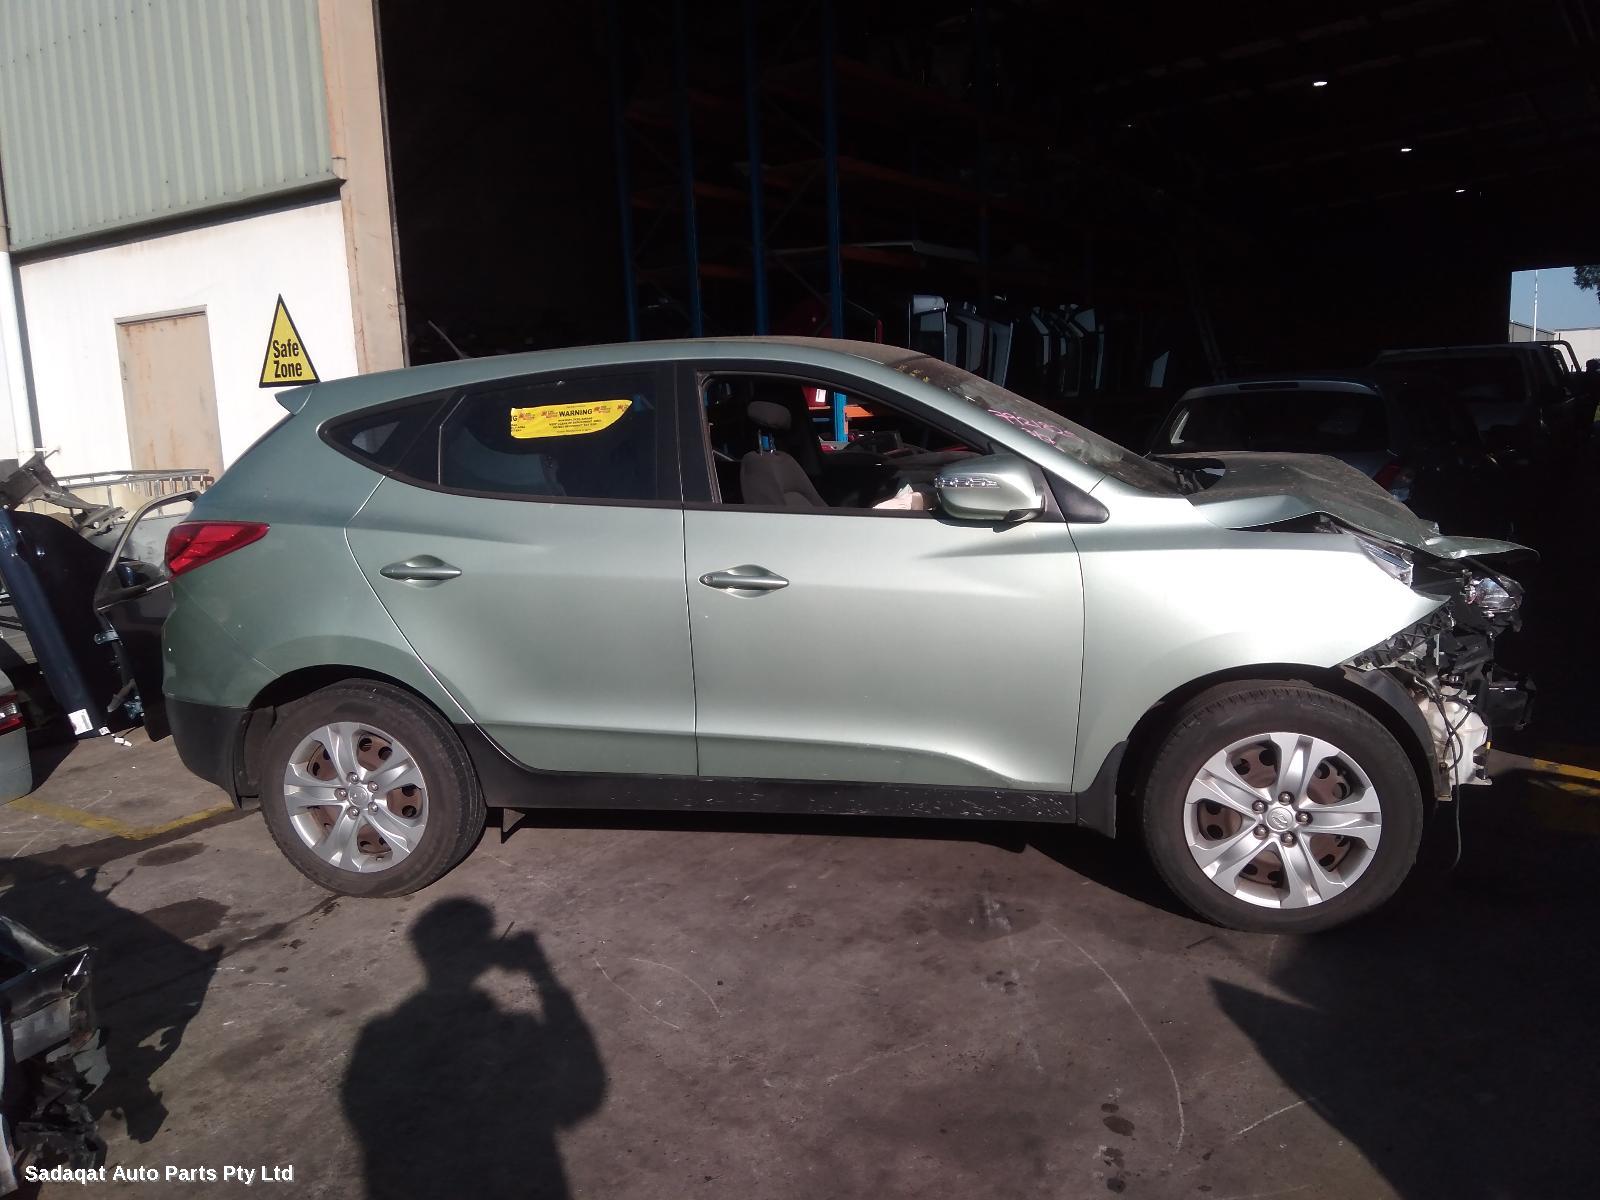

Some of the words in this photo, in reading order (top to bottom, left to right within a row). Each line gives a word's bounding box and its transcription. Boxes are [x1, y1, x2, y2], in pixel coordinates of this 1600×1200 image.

[273, 339, 299, 358] Safe
[274, 360, 302, 378] Zone
[559, 409, 593, 417] WARNING
